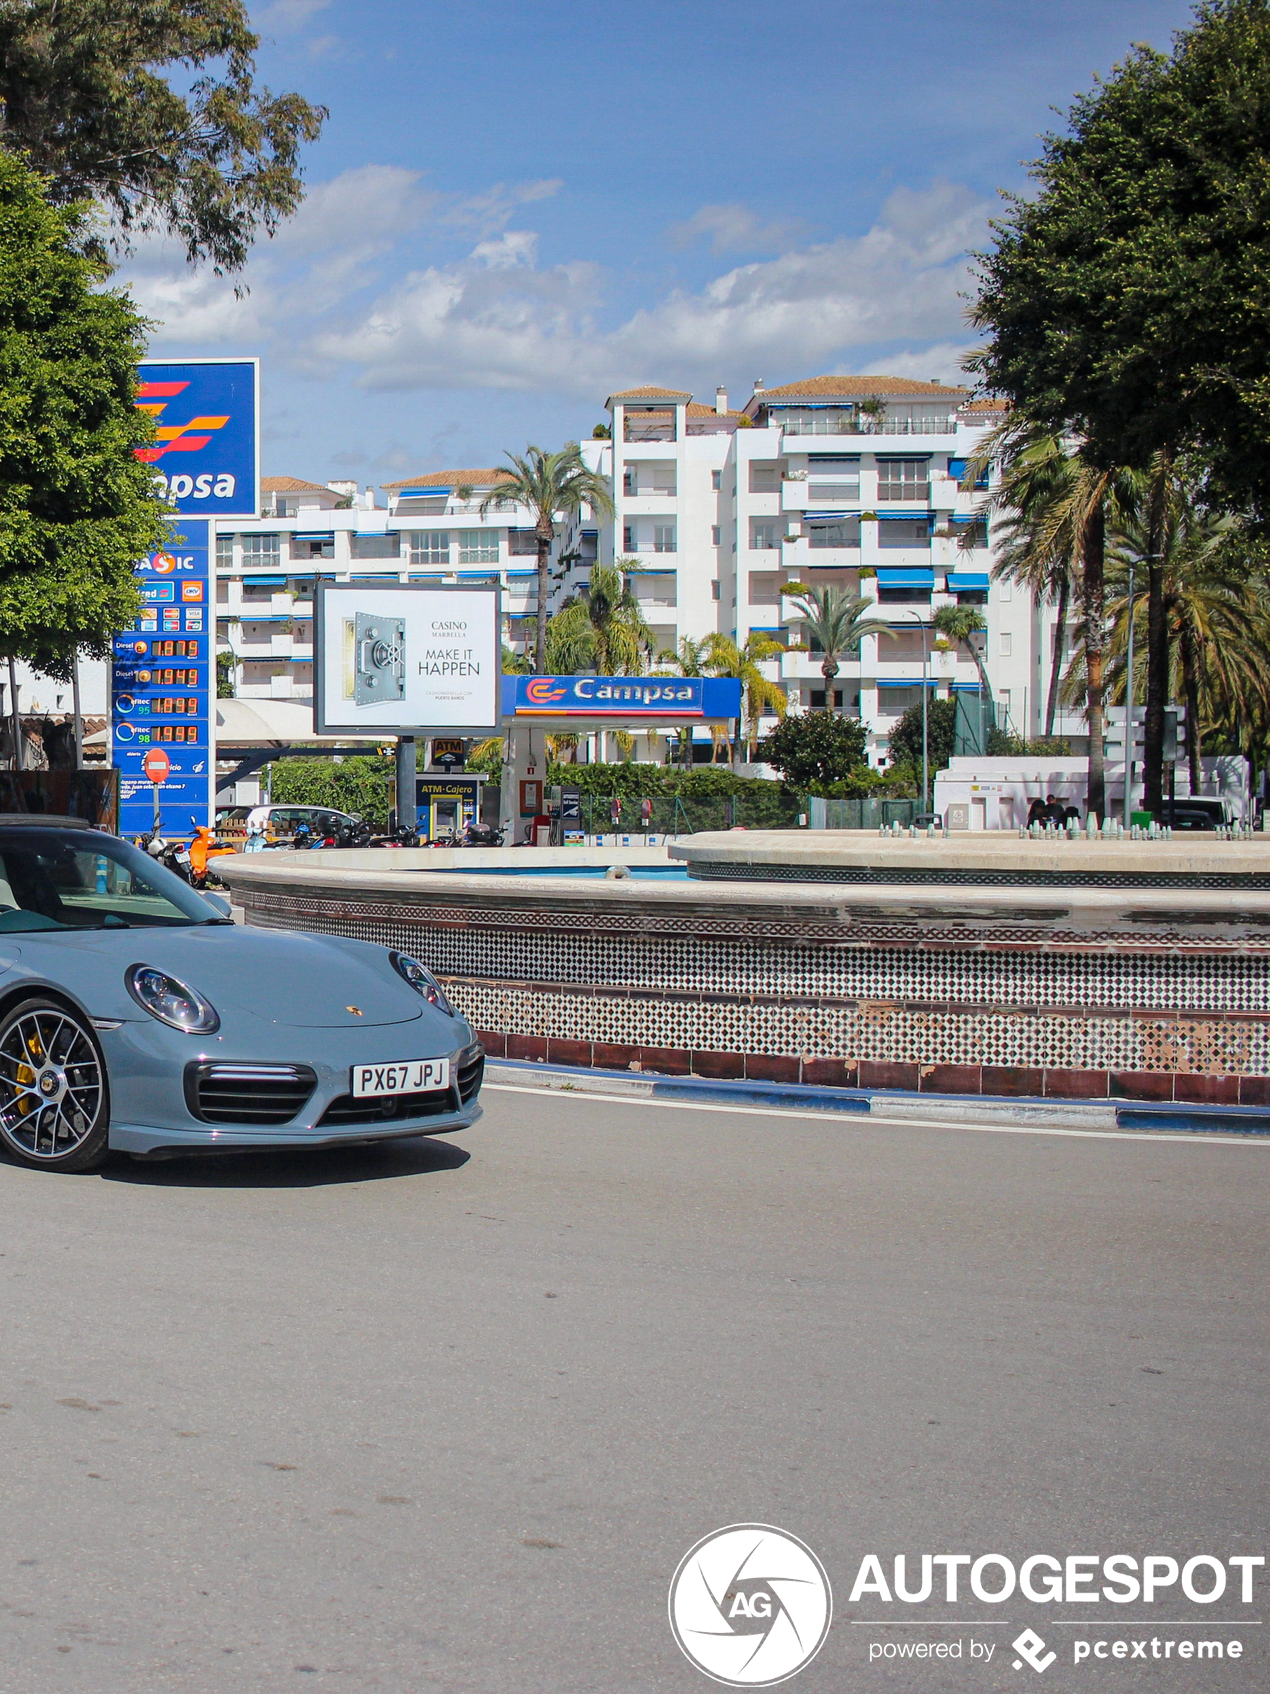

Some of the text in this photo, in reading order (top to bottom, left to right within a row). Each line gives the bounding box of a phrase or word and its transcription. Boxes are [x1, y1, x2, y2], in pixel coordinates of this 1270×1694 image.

[134, 555, 194, 572] ASIC
[431, 621, 467, 630] CASINO
[425, 649, 473, 660] MAKE IT
[418, 662, 480, 676] HAPPEN
[573, 679, 693, 704] Campsa
[138, 706, 150, 715] 95
[138, 734, 151, 743] 98
[436, 741, 461, 751] ATM
[361, 1063, 443, 1092] PX67 JPJ
